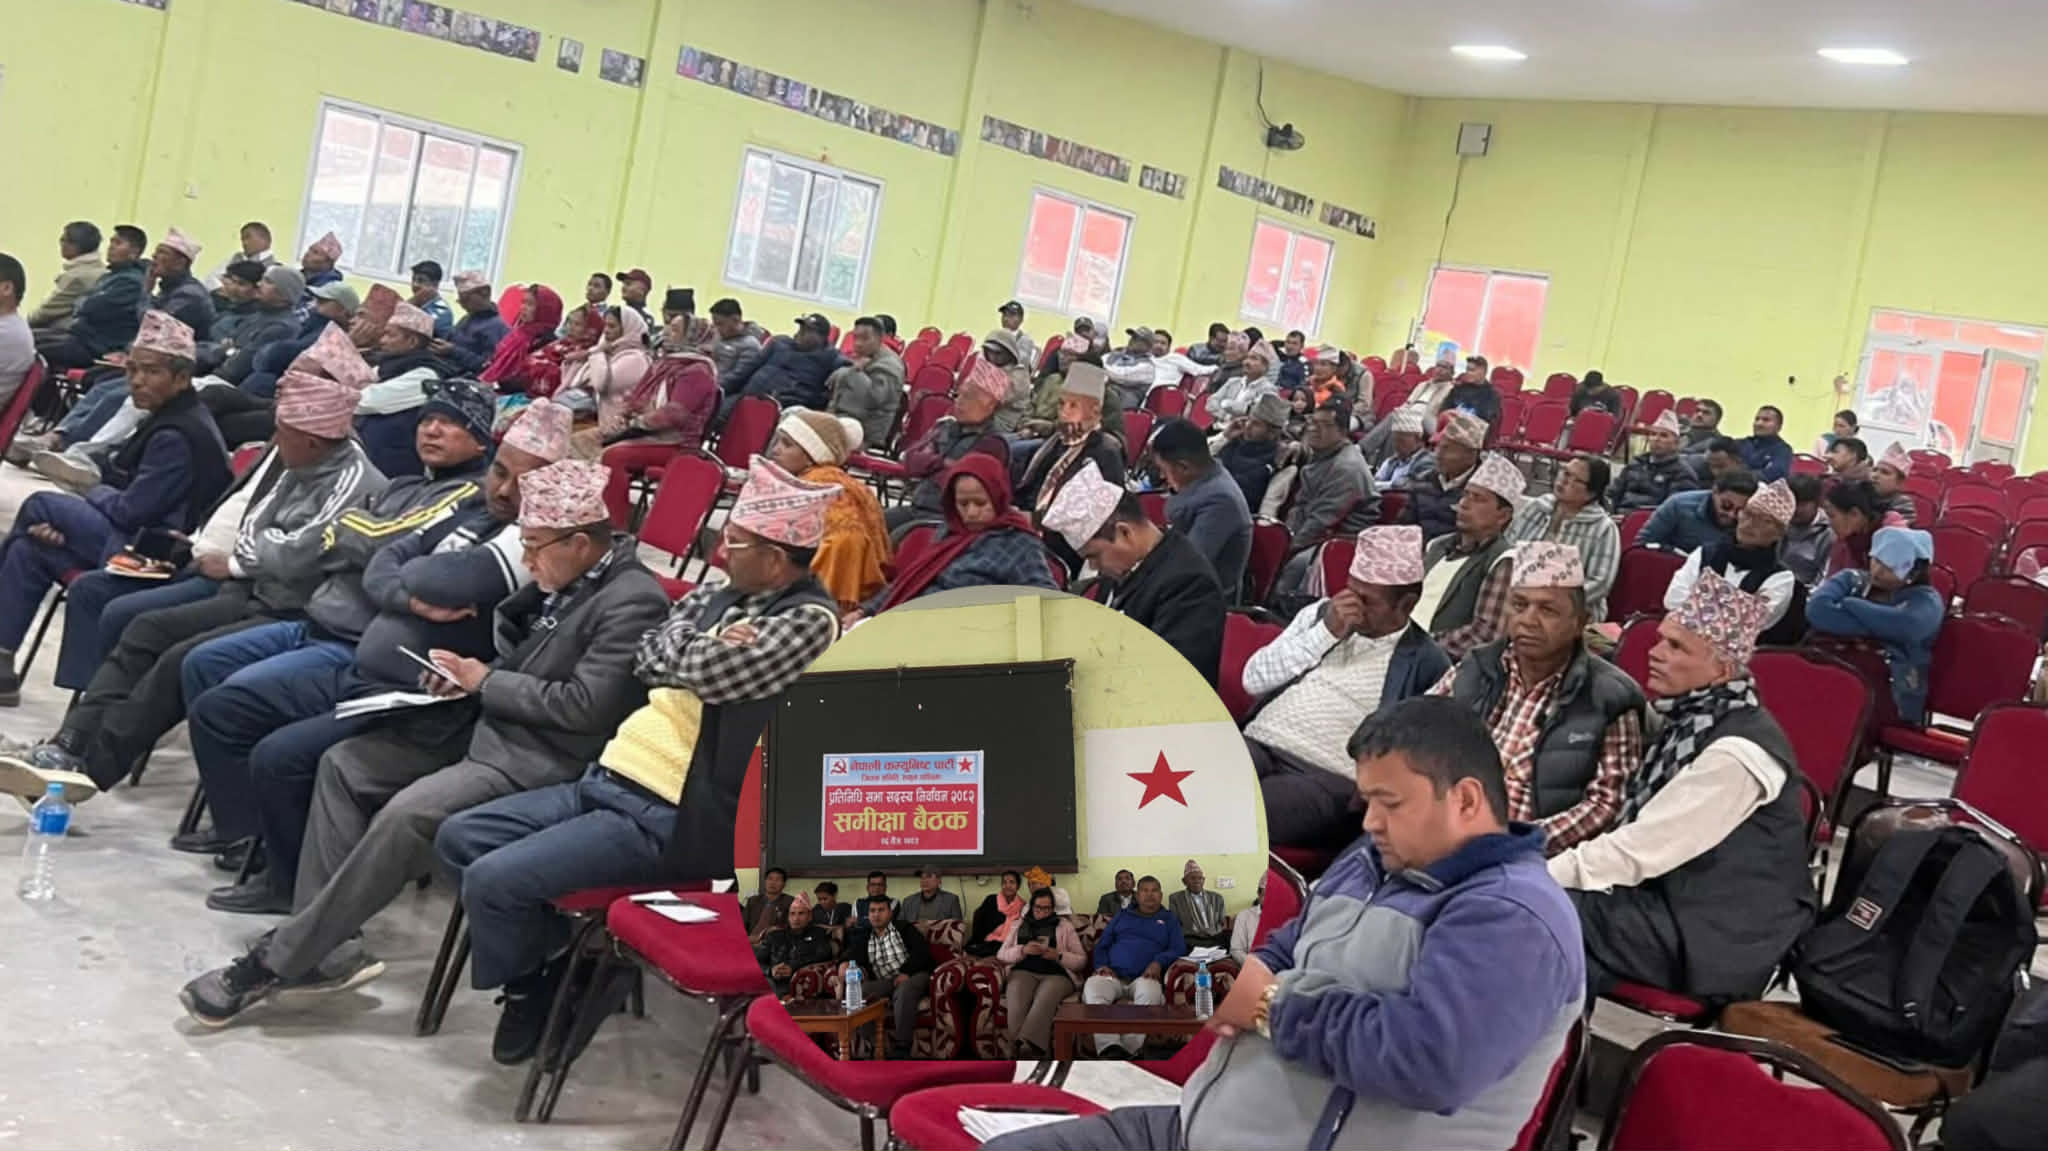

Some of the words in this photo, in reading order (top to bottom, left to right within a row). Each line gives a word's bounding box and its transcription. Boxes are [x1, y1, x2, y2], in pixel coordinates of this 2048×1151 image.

[829, 788, 863, 805] प्रतिनिधि
[865, 790, 883, 803] सभा
[886, 790, 913, 805] सदस्य
[915, 787, 949, 803] निर्वाचन
[951, 789, 975, 805] २०८२
[832, 806, 907, 833] समीक्षा
[912, 804, 969, 831] बैठक
